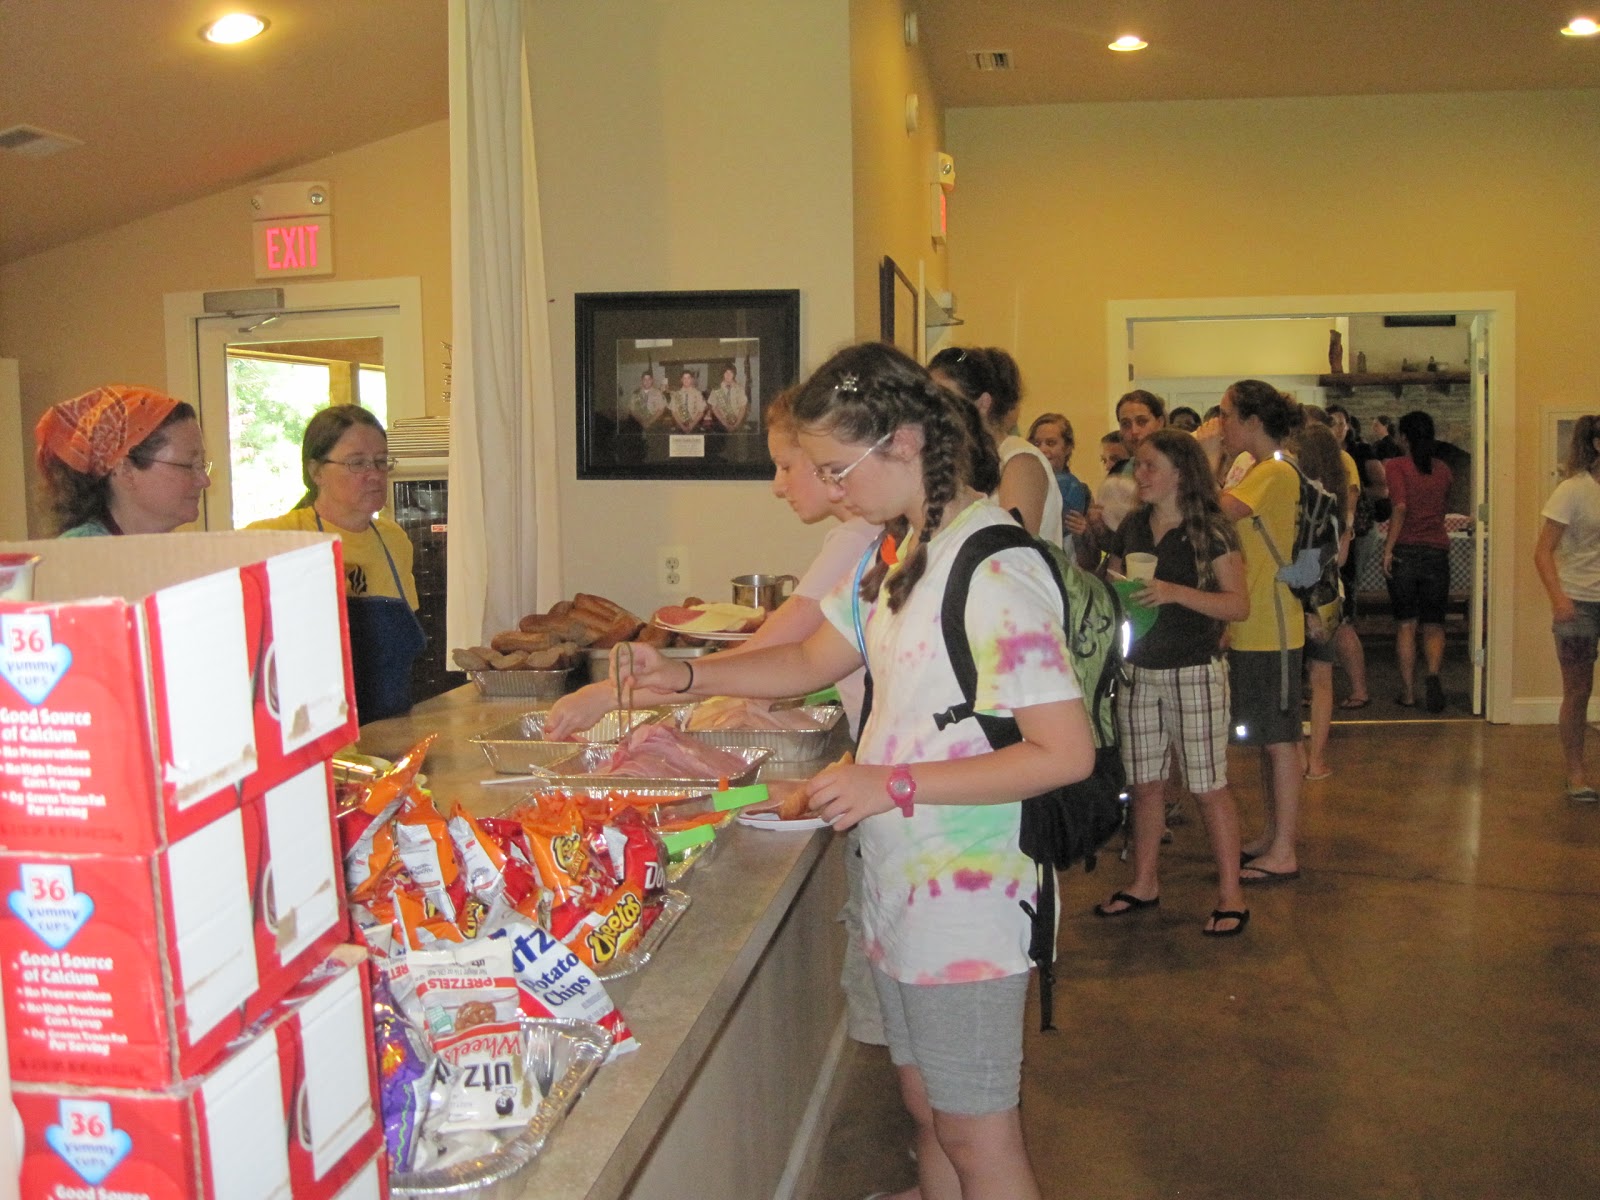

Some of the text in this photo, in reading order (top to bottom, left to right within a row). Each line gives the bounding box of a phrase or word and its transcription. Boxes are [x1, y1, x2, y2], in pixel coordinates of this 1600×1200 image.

[266, 225, 319, 270] EXIT
[11, 628, 45, 652] 36
[0, 707, 92, 726] Good Source
[2, 725, 77, 743] of Calcium
[645, 861, 666, 889] Do
[31, 877, 66, 901] 36
[28, 908, 78, 920] yummy
[588, 894, 641, 963] Cheetos
[20, 950, 113, 971] Good Source
[520, 952, 580, 993] Potato
[23, 968, 99, 986] of Calcium
[427, 977, 494, 989] PRETZELS
[543, 974, 592, 1007] Chips
[444, 1036, 521, 1067] Wheels
[464, 1062, 512, 1092] utz
[71, 1112, 105, 1138] 36
[54, 1184, 95, 1200] Good
